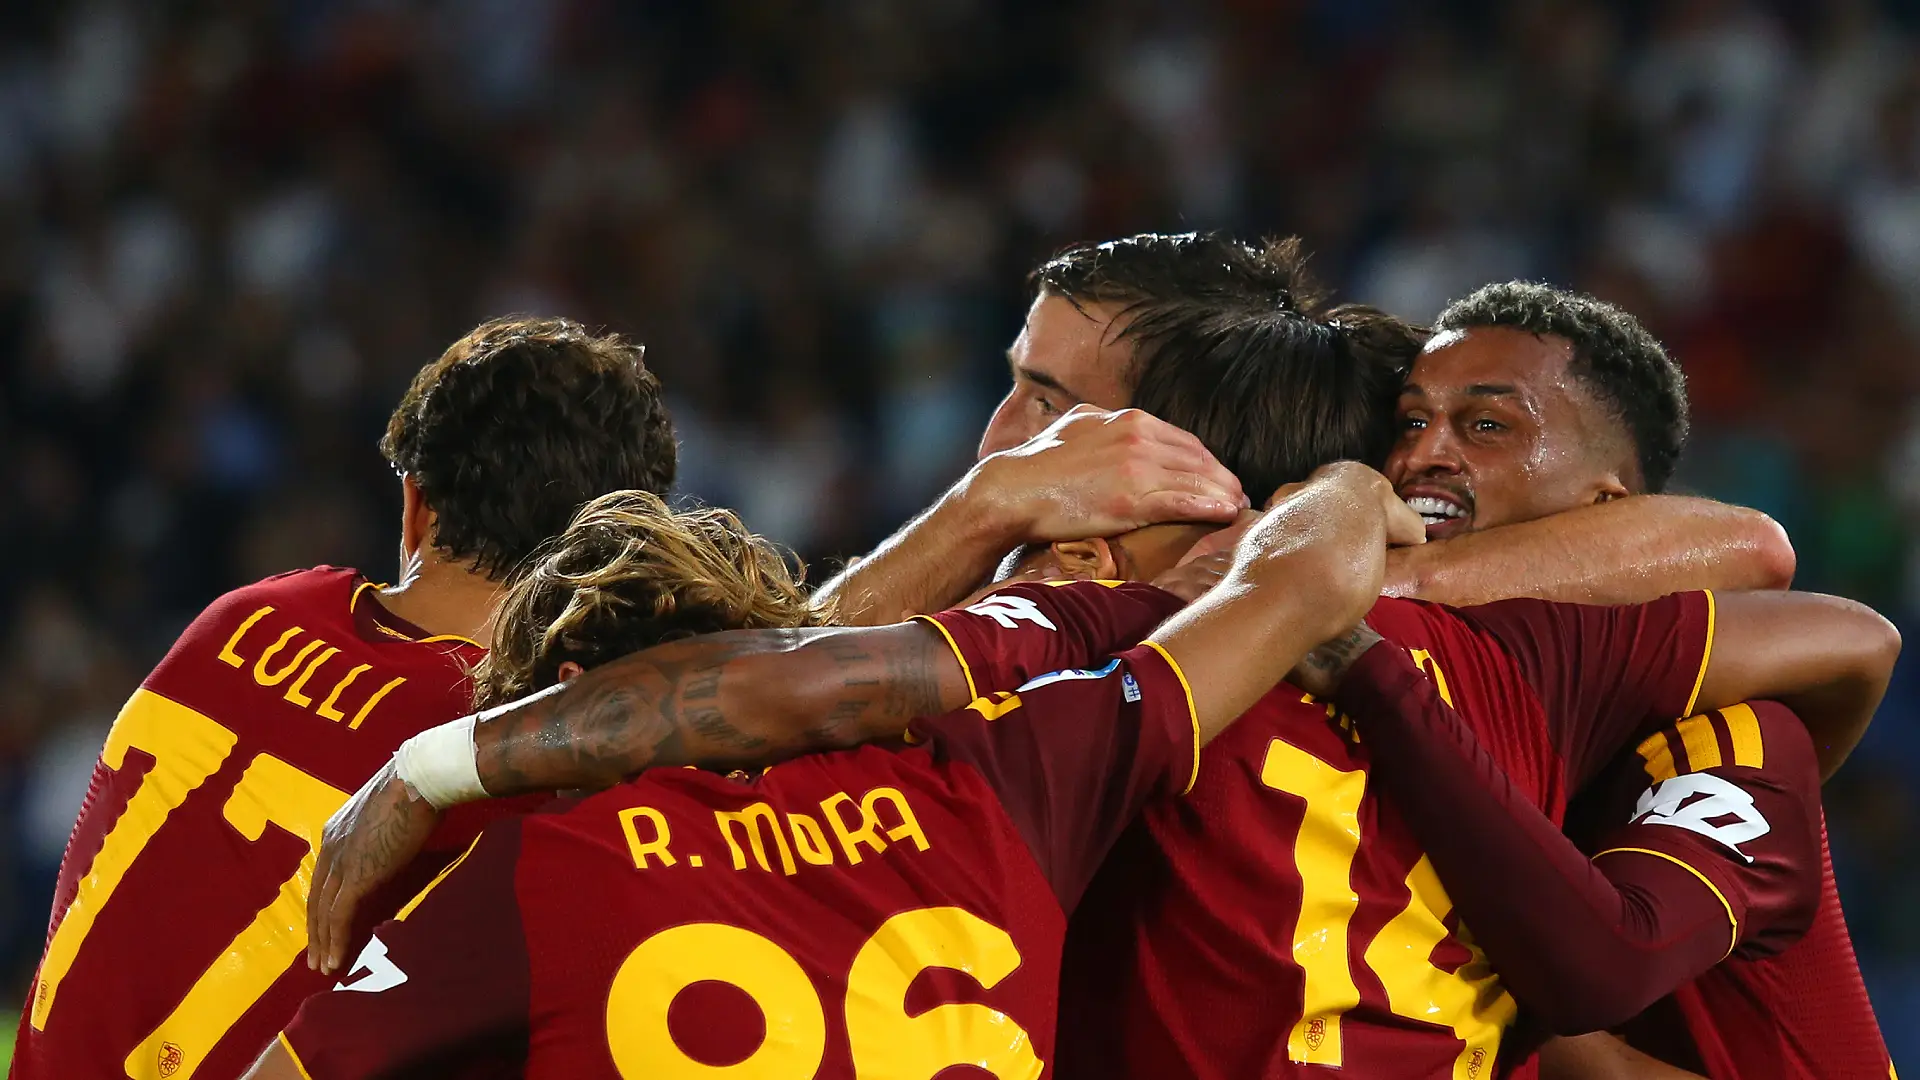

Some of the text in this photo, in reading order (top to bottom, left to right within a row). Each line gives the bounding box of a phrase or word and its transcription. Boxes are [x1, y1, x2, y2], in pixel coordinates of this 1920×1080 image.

[217, 605, 406, 730] LULLI
[31, 688, 352, 1080] 77
[617, 806, 704, 869] R.
[1260, 738, 1516, 1080] 14
